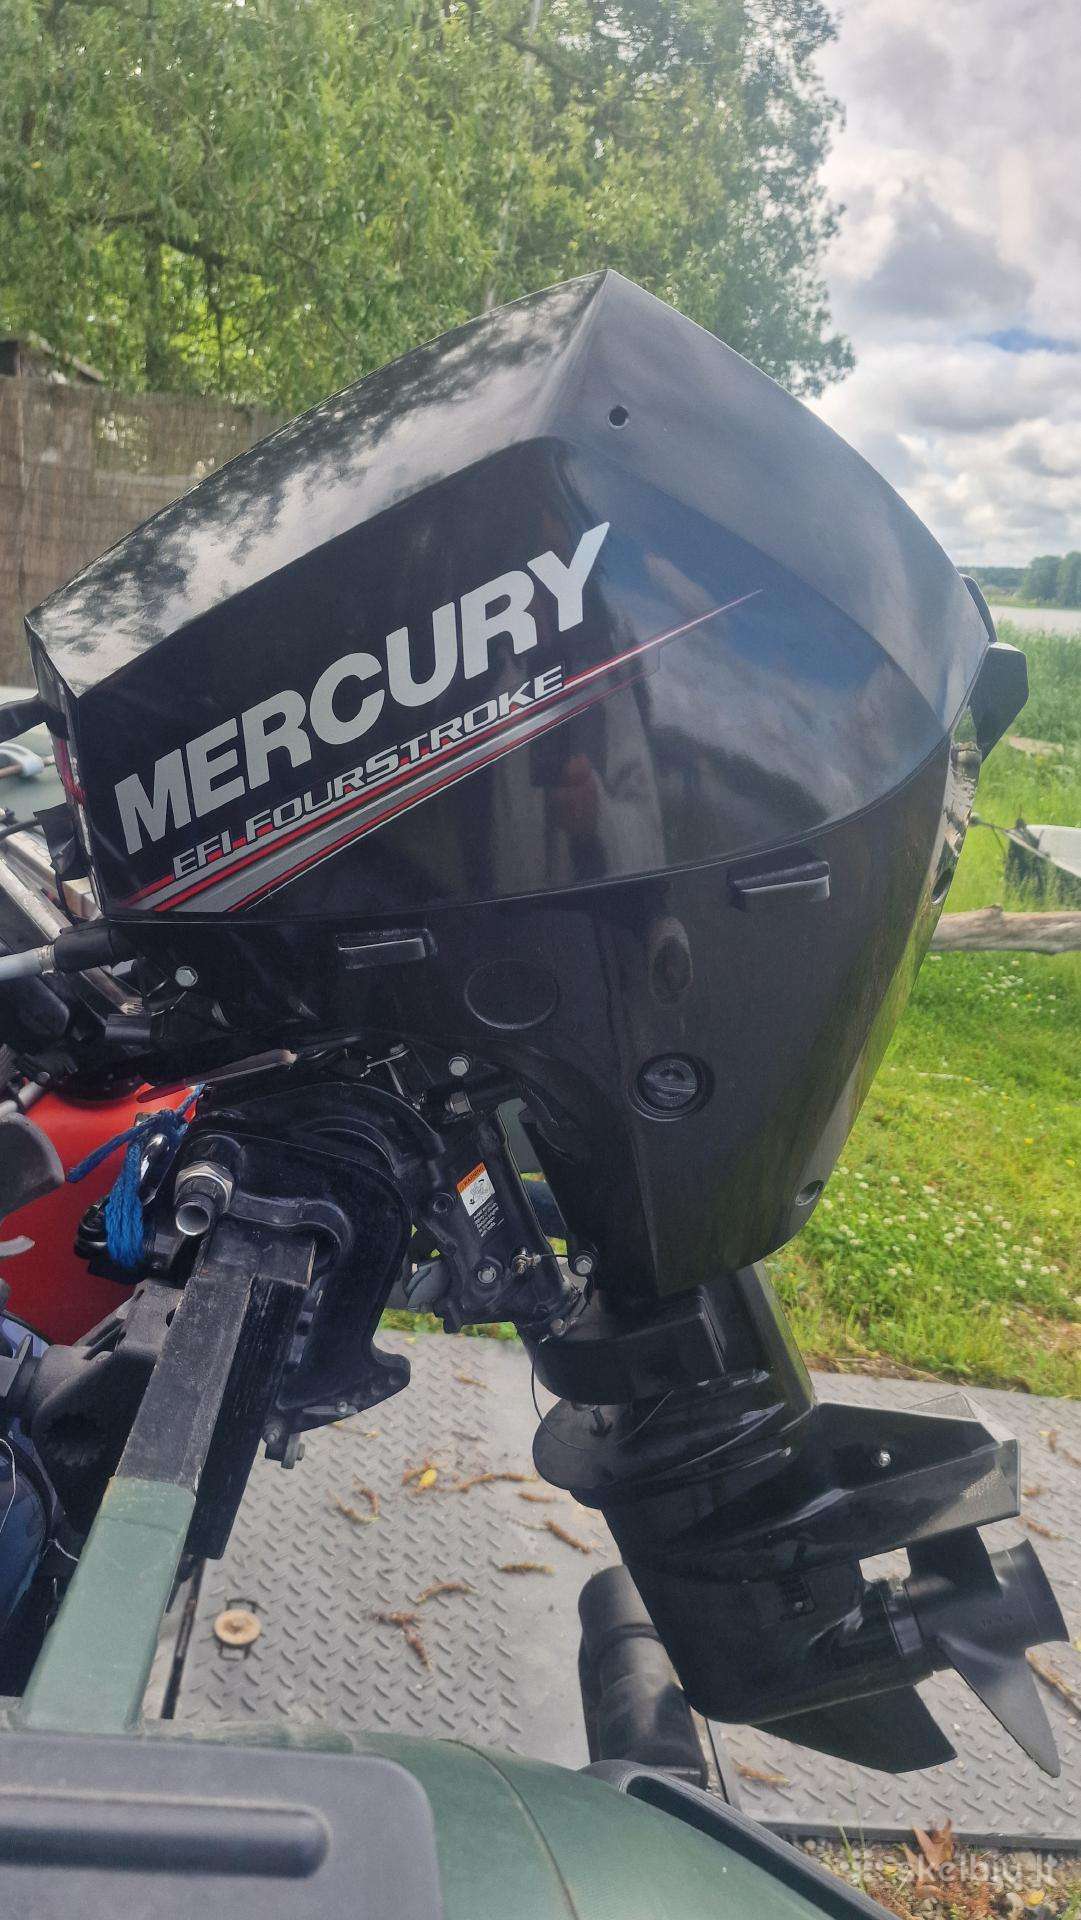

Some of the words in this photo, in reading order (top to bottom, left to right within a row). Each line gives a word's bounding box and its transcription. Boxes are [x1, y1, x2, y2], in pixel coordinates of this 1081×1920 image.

[114, 522, 610, 855] MERCURY
[173, 829, 232, 879] EFI
[246, 665, 563, 842] FOURSTROKE
